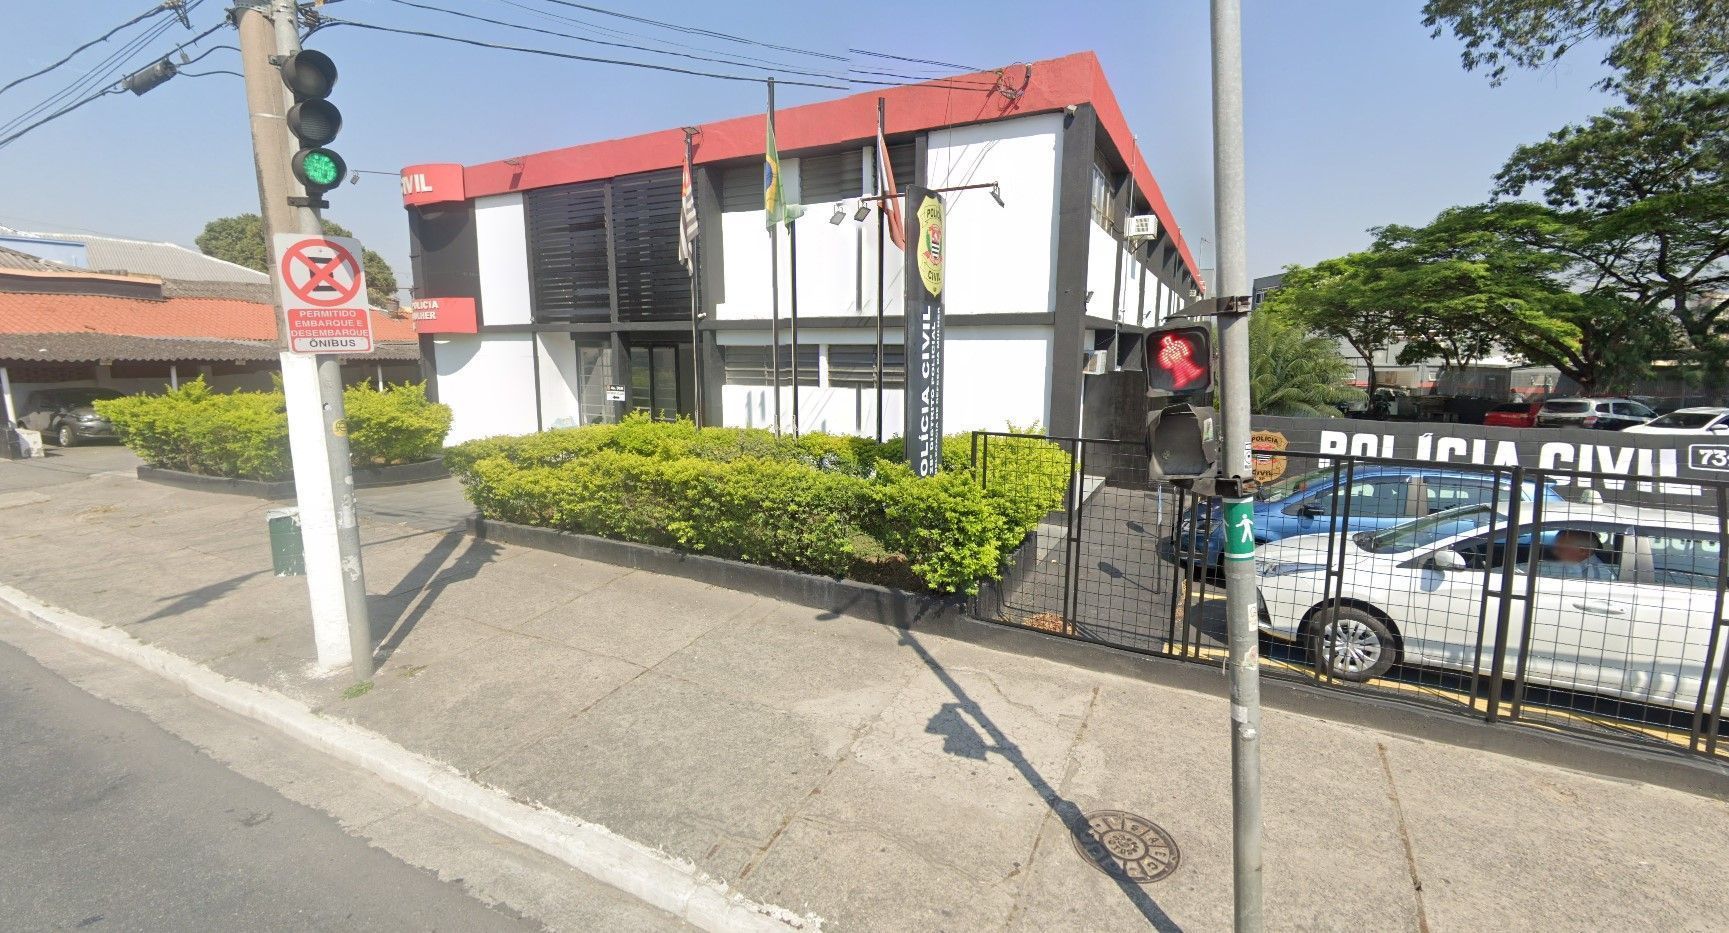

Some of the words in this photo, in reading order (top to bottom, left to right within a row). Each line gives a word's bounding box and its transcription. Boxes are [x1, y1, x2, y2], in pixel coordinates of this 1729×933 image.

[299, 310, 356, 318] PERMITIDO
[294, 319, 355, 328] EMBARQUE
[356, 319, 364, 327] E
[290, 329, 369, 337] DESEMBARQUE
[309, 338, 356, 348] ÔNIBUS
[922, 305, 931, 379] CIVIL
[919, 386, 930, 477] OLÍCIA
[1251, 436, 1279, 444] POLÍCIA
[1699, 449, 1729, 467] 73
[1539, 442, 1702, 496] CIVIL
